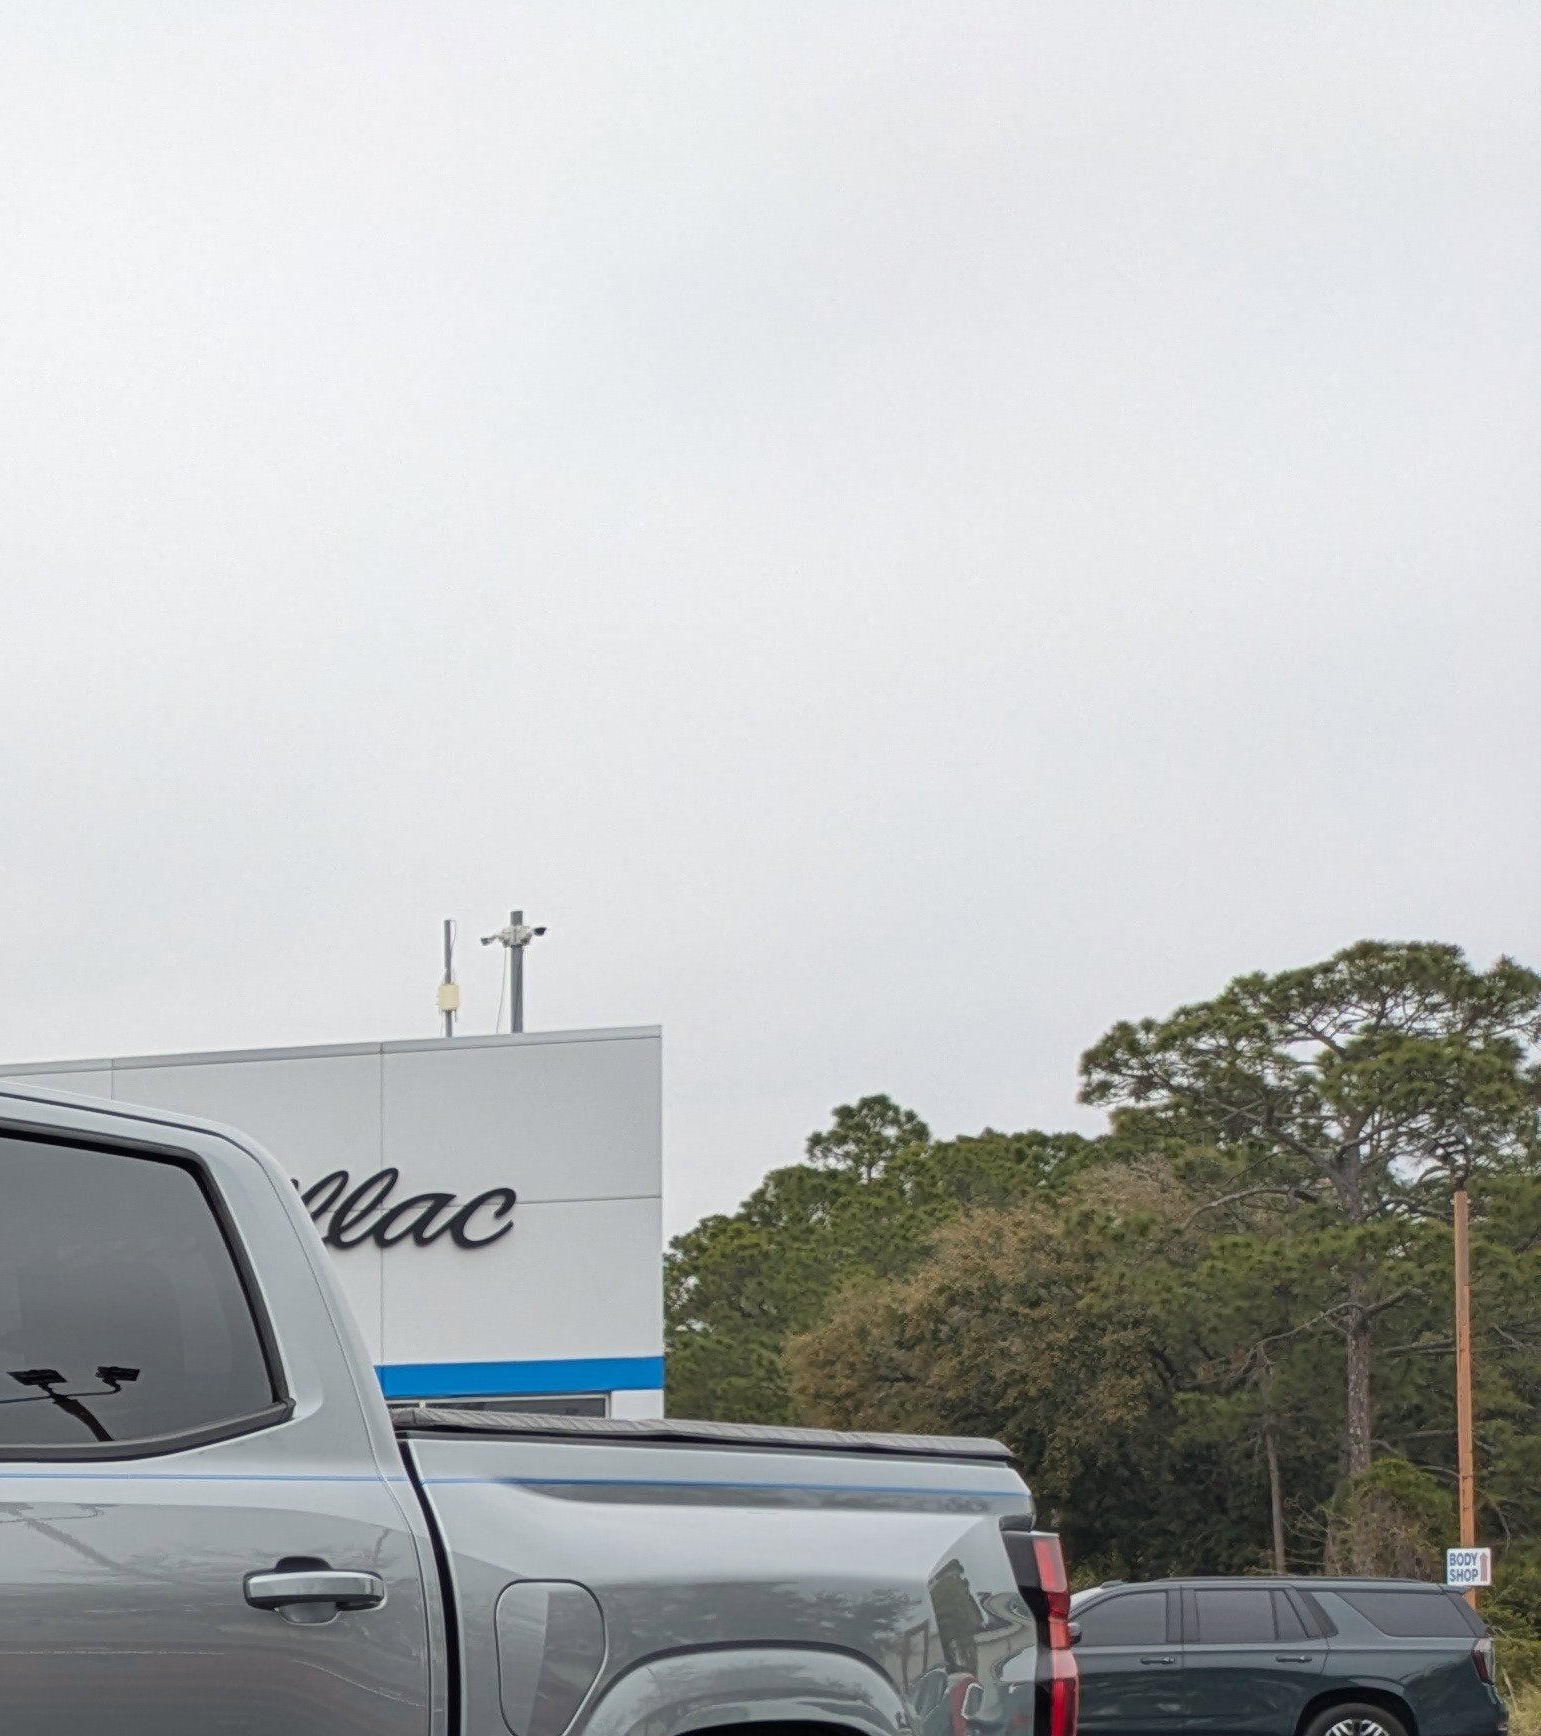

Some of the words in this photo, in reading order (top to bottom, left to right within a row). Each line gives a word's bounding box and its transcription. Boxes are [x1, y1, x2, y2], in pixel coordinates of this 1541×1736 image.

[291, 1167, 517, 1249] llac
[1449, 1553, 1477, 1566] BODY
[1449, 1569, 1479, 1582] SHOP
